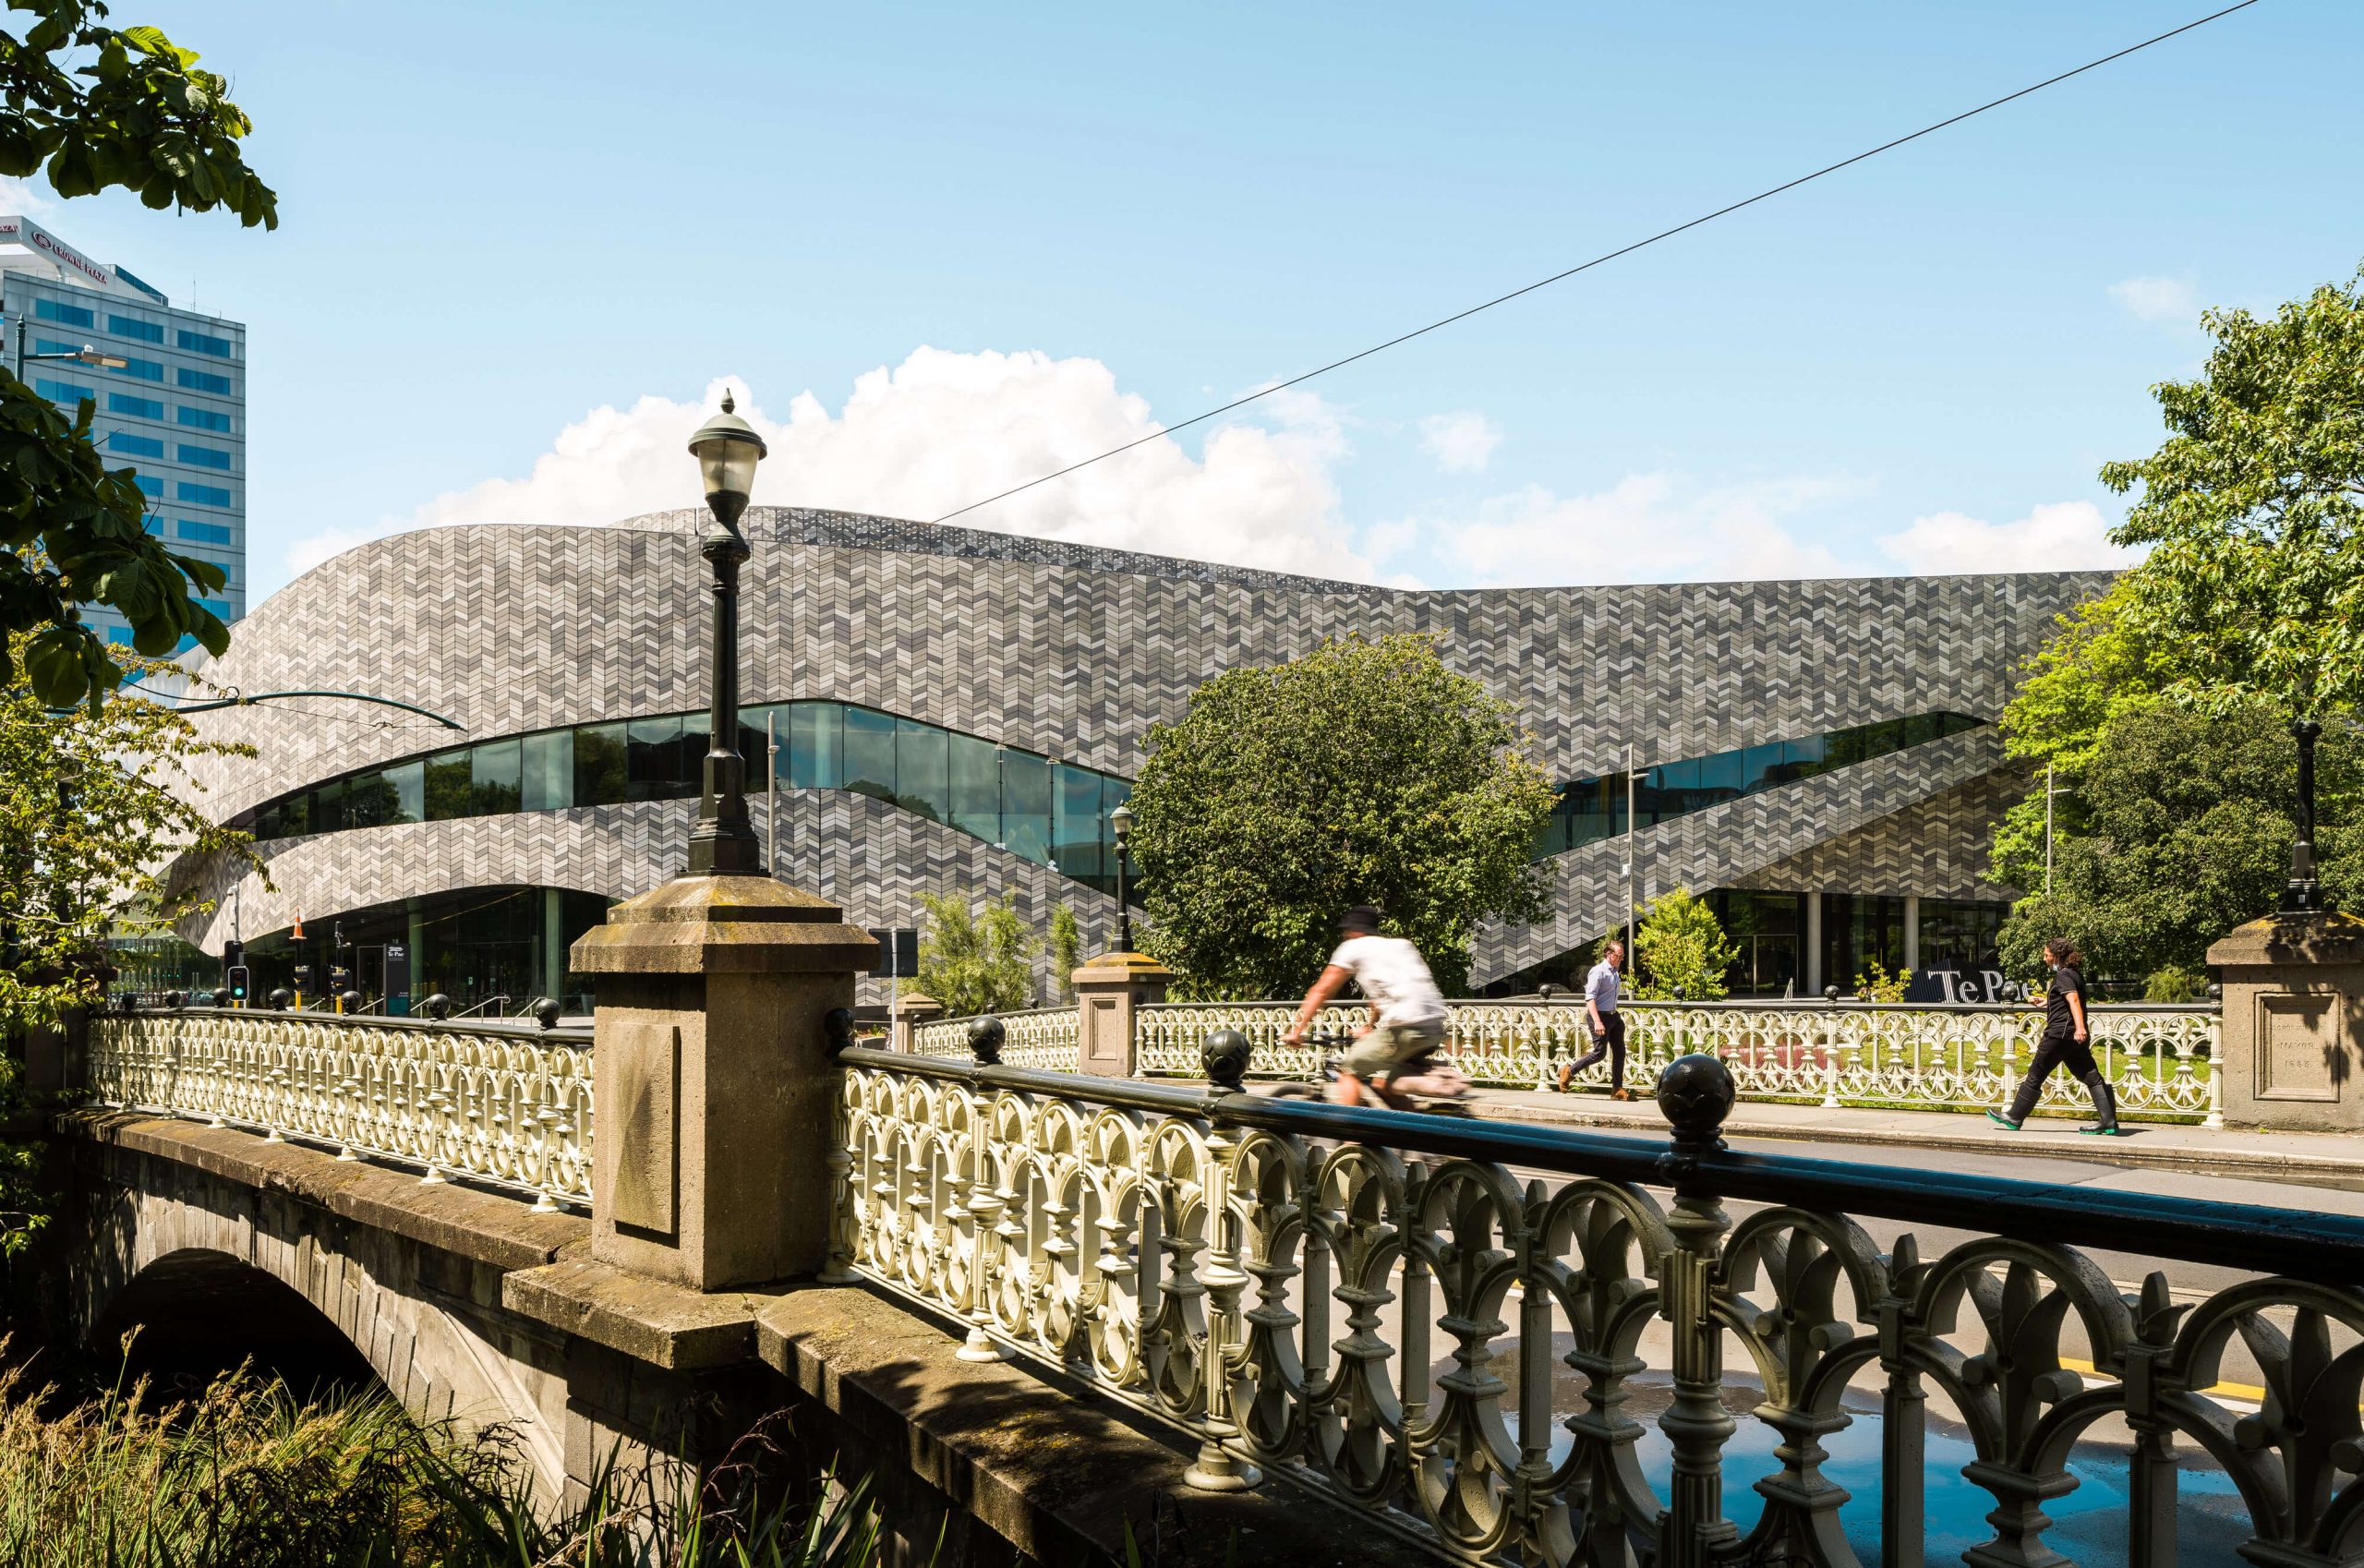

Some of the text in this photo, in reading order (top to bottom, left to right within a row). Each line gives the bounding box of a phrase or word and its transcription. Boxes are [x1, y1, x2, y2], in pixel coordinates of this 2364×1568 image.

[53, 244, 108, 284] CROWNE PLAZA
[1928, 971, 1979, 1004] Te
